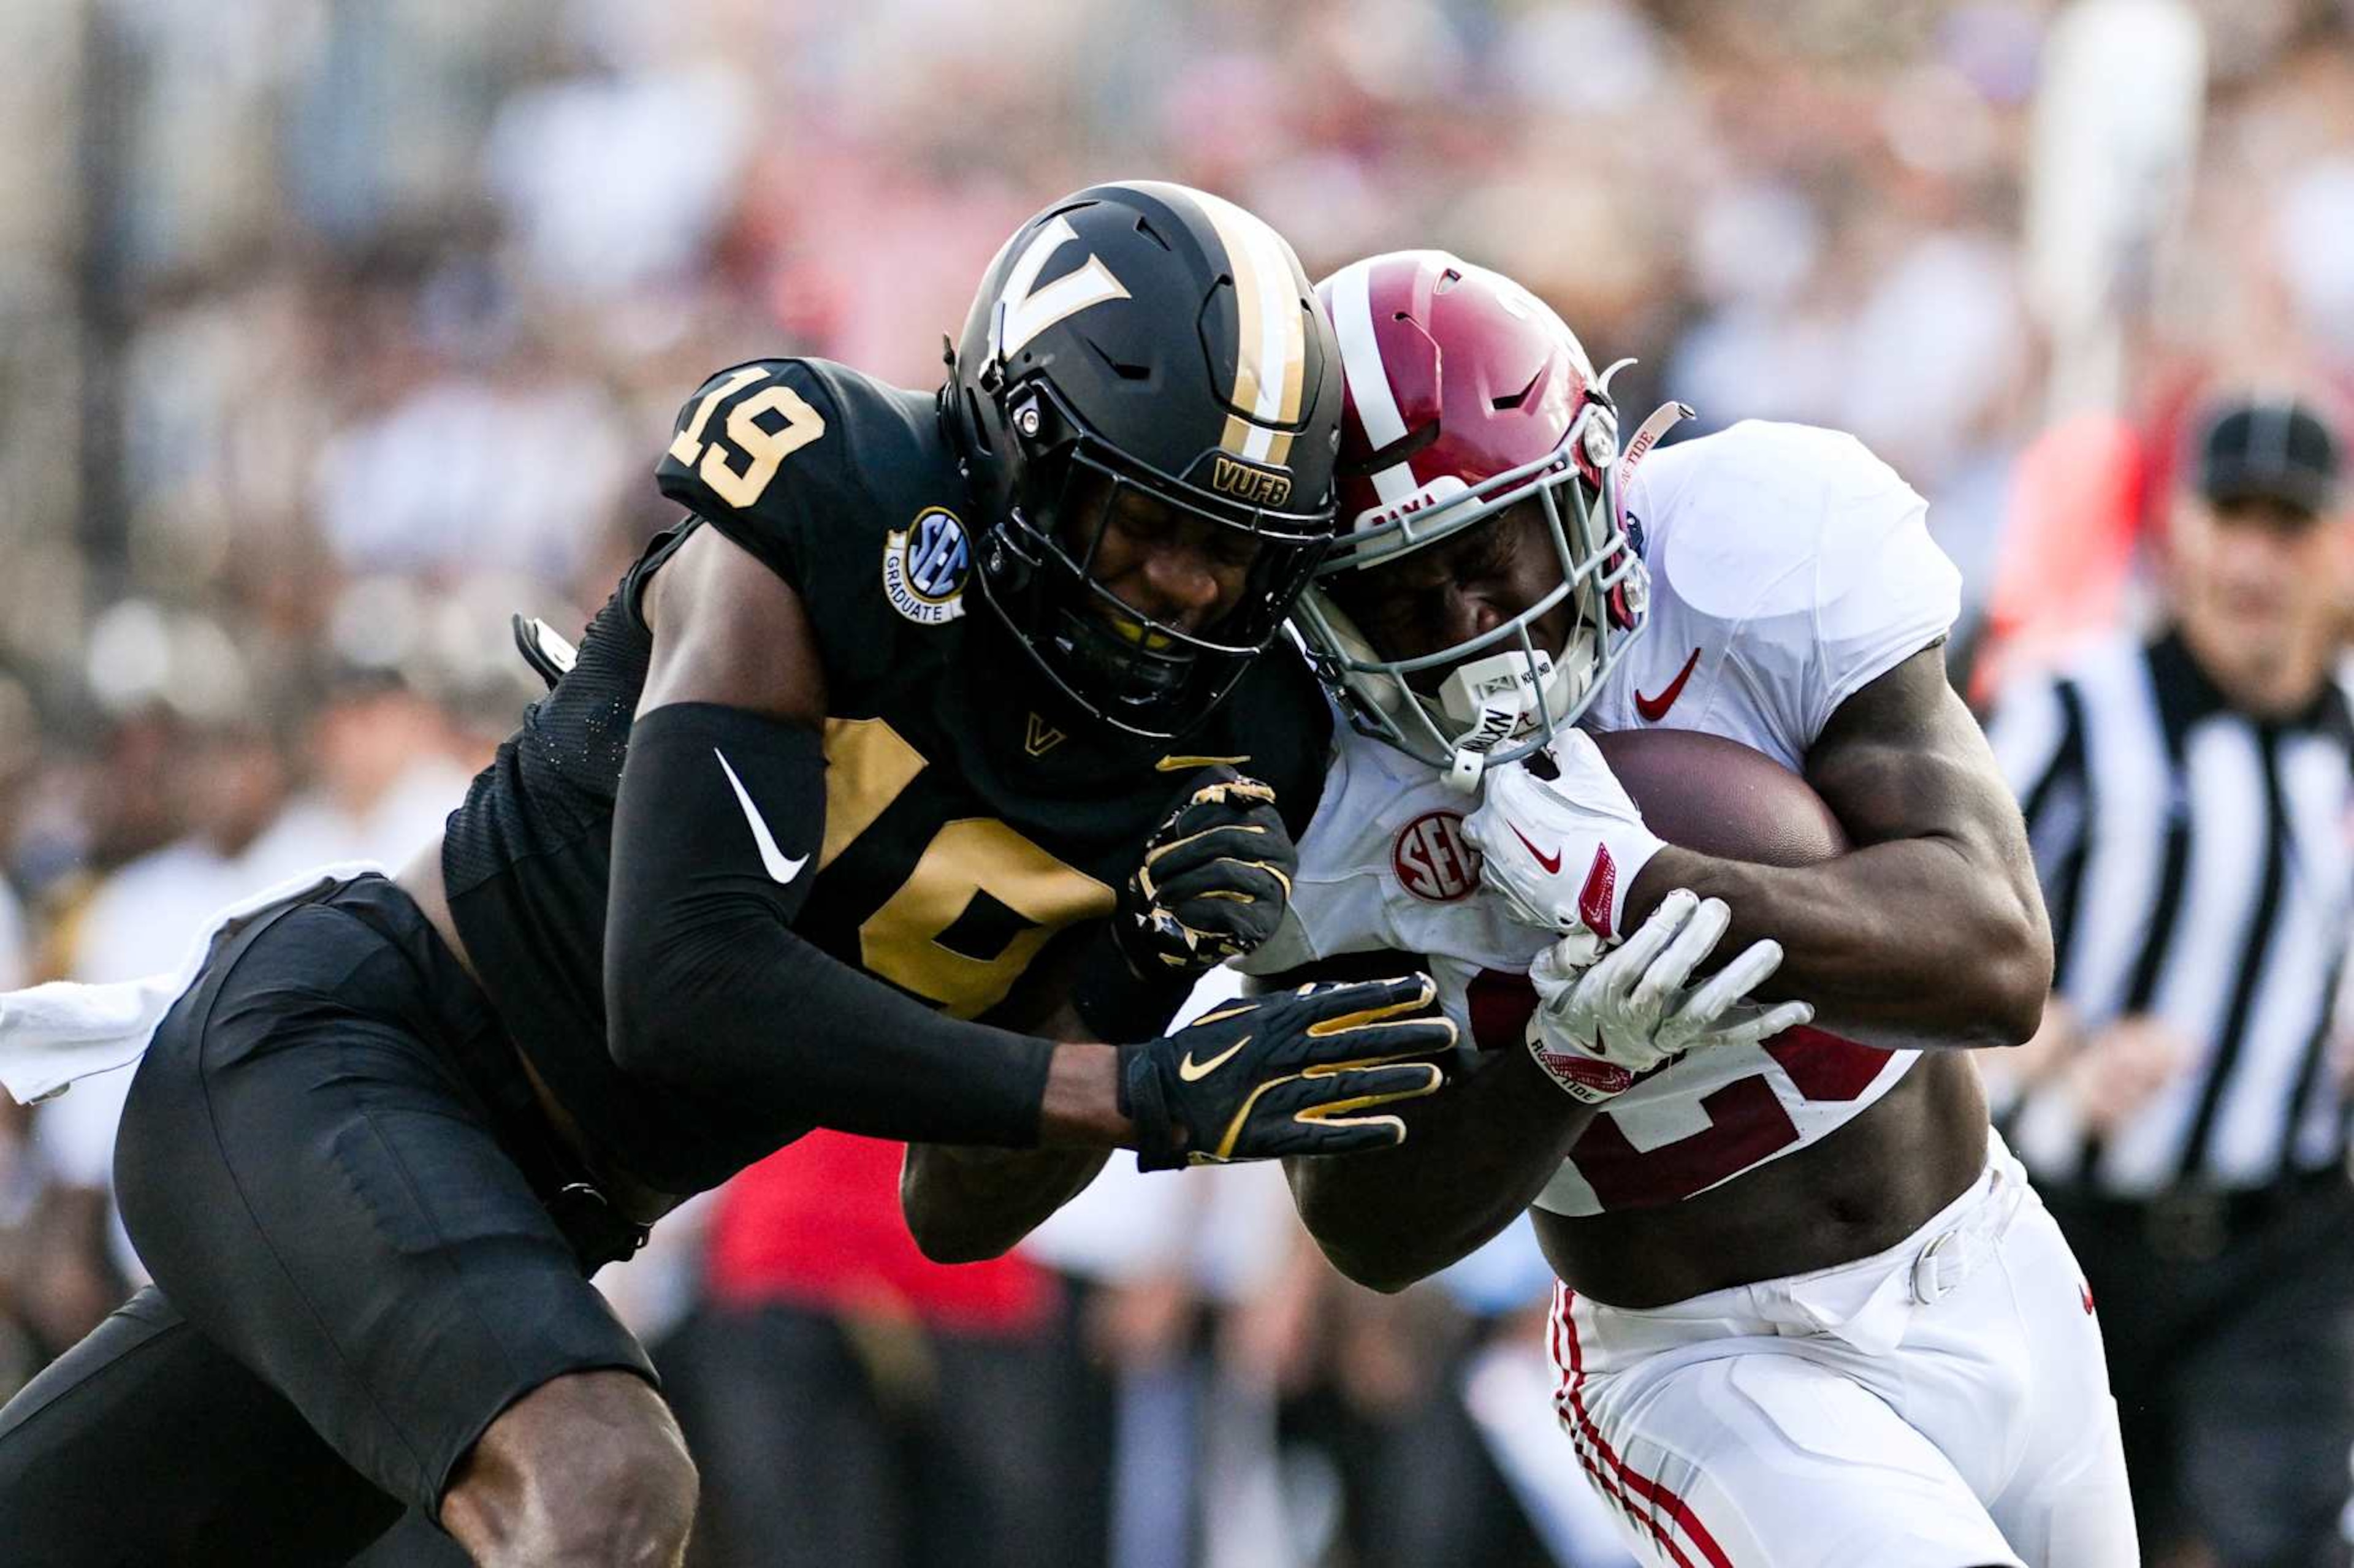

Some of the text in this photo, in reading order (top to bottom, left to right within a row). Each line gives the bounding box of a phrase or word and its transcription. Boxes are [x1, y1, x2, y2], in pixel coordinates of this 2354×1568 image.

[1000, 215, 1132, 362] V
[669, 367, 826, 508] 19
[1213, 457, 1292, 507] VUFB
[888, 556, 943, 621] GRADUATE
[908, 514, 969, 596] SEC
